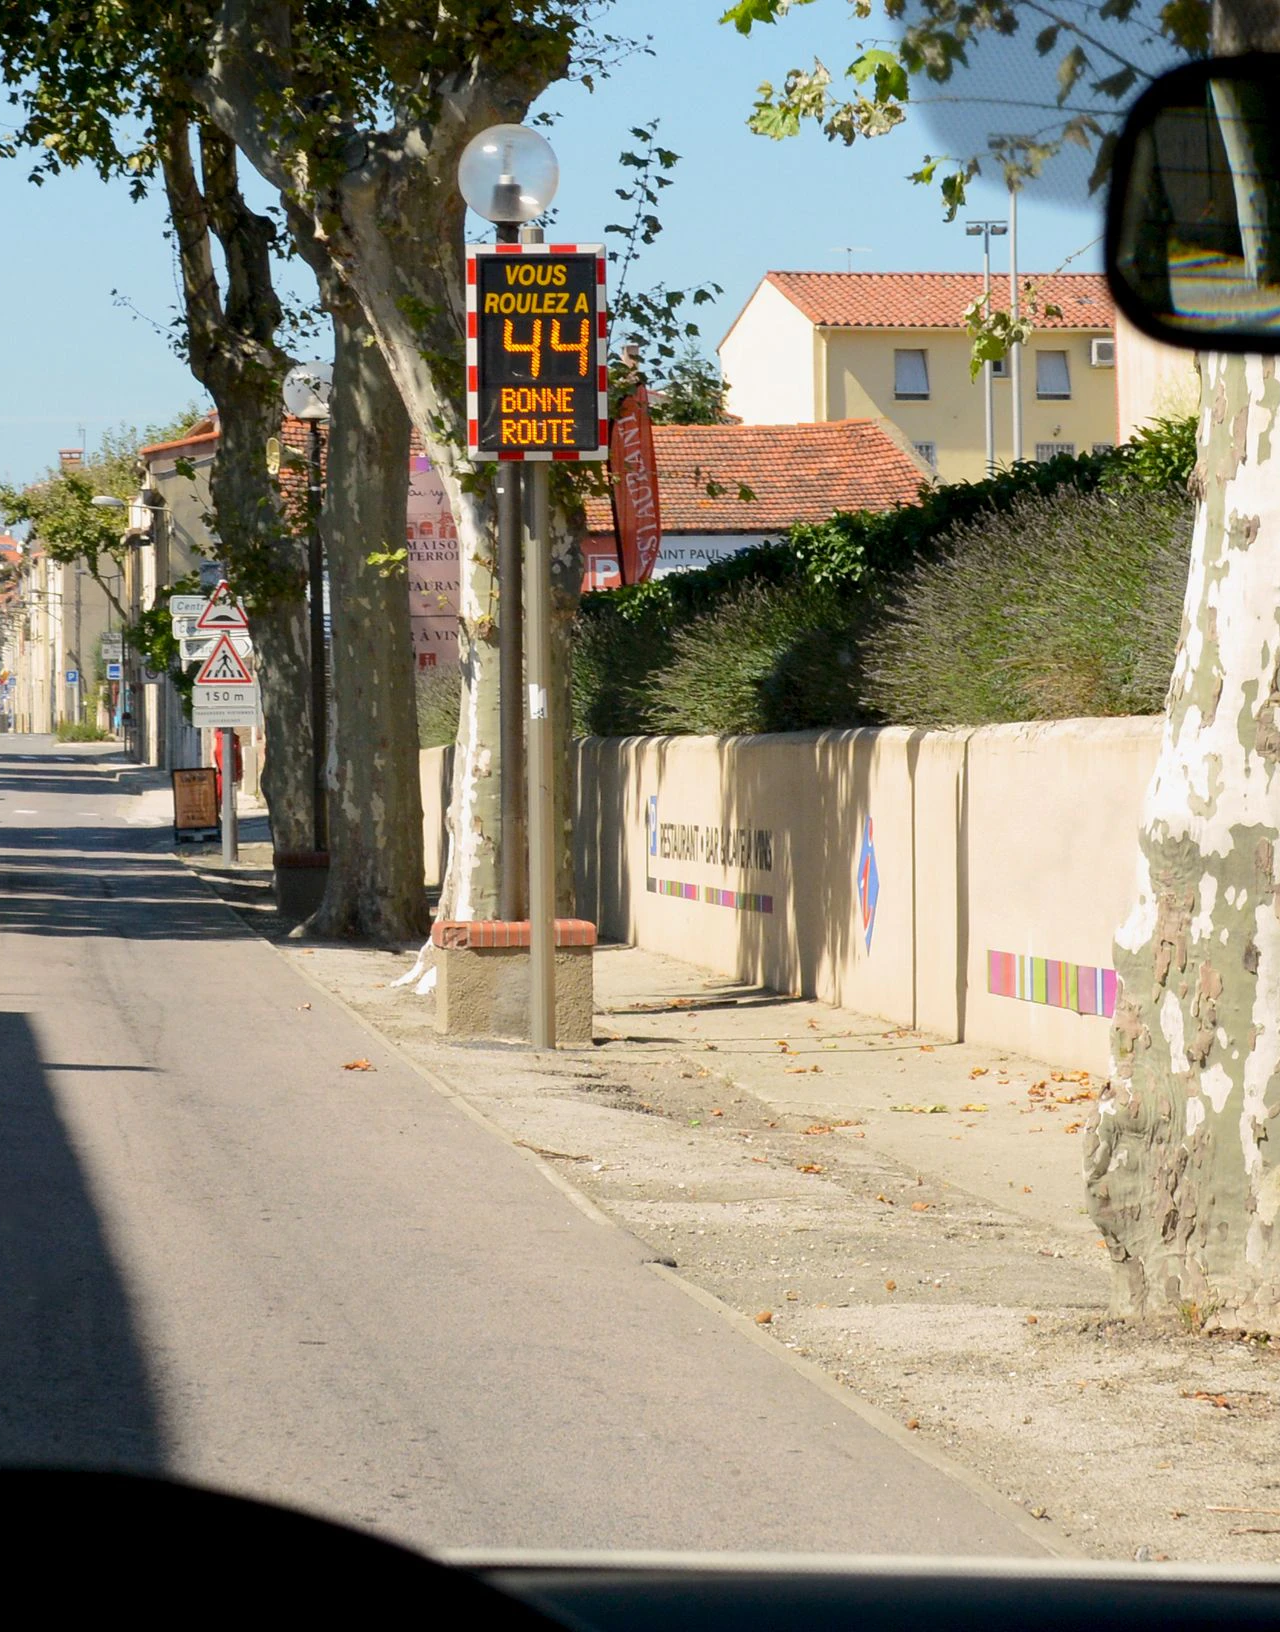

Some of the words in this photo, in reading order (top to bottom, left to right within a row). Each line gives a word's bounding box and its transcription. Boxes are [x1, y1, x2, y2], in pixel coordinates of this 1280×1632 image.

[505, 264, 568, 287] VOUS
[484, 292, 569, 314] ROULEZ
[574, 292, 590, 314] A
[503, 318, 591, 378] 44
[501, 387, 575, 413] BONNE
[501, 418, 576, 445] ROUTE
[617, 413, 658, 568] ESTAURANT
[407, 540, 458, 551] MAISO
[408, 551, 460, 561] TERROI
[656, 549, 686, 560] AINT
[690, 549, 722, 560] PAUL
[177, 601, 206, 612] Centr
[206, 691, 230, 702] 150
[234, 693, 244, 701] m
[659, 822, 700, 862] RESTAURANT
[705, 826, 719, 865] BAR
